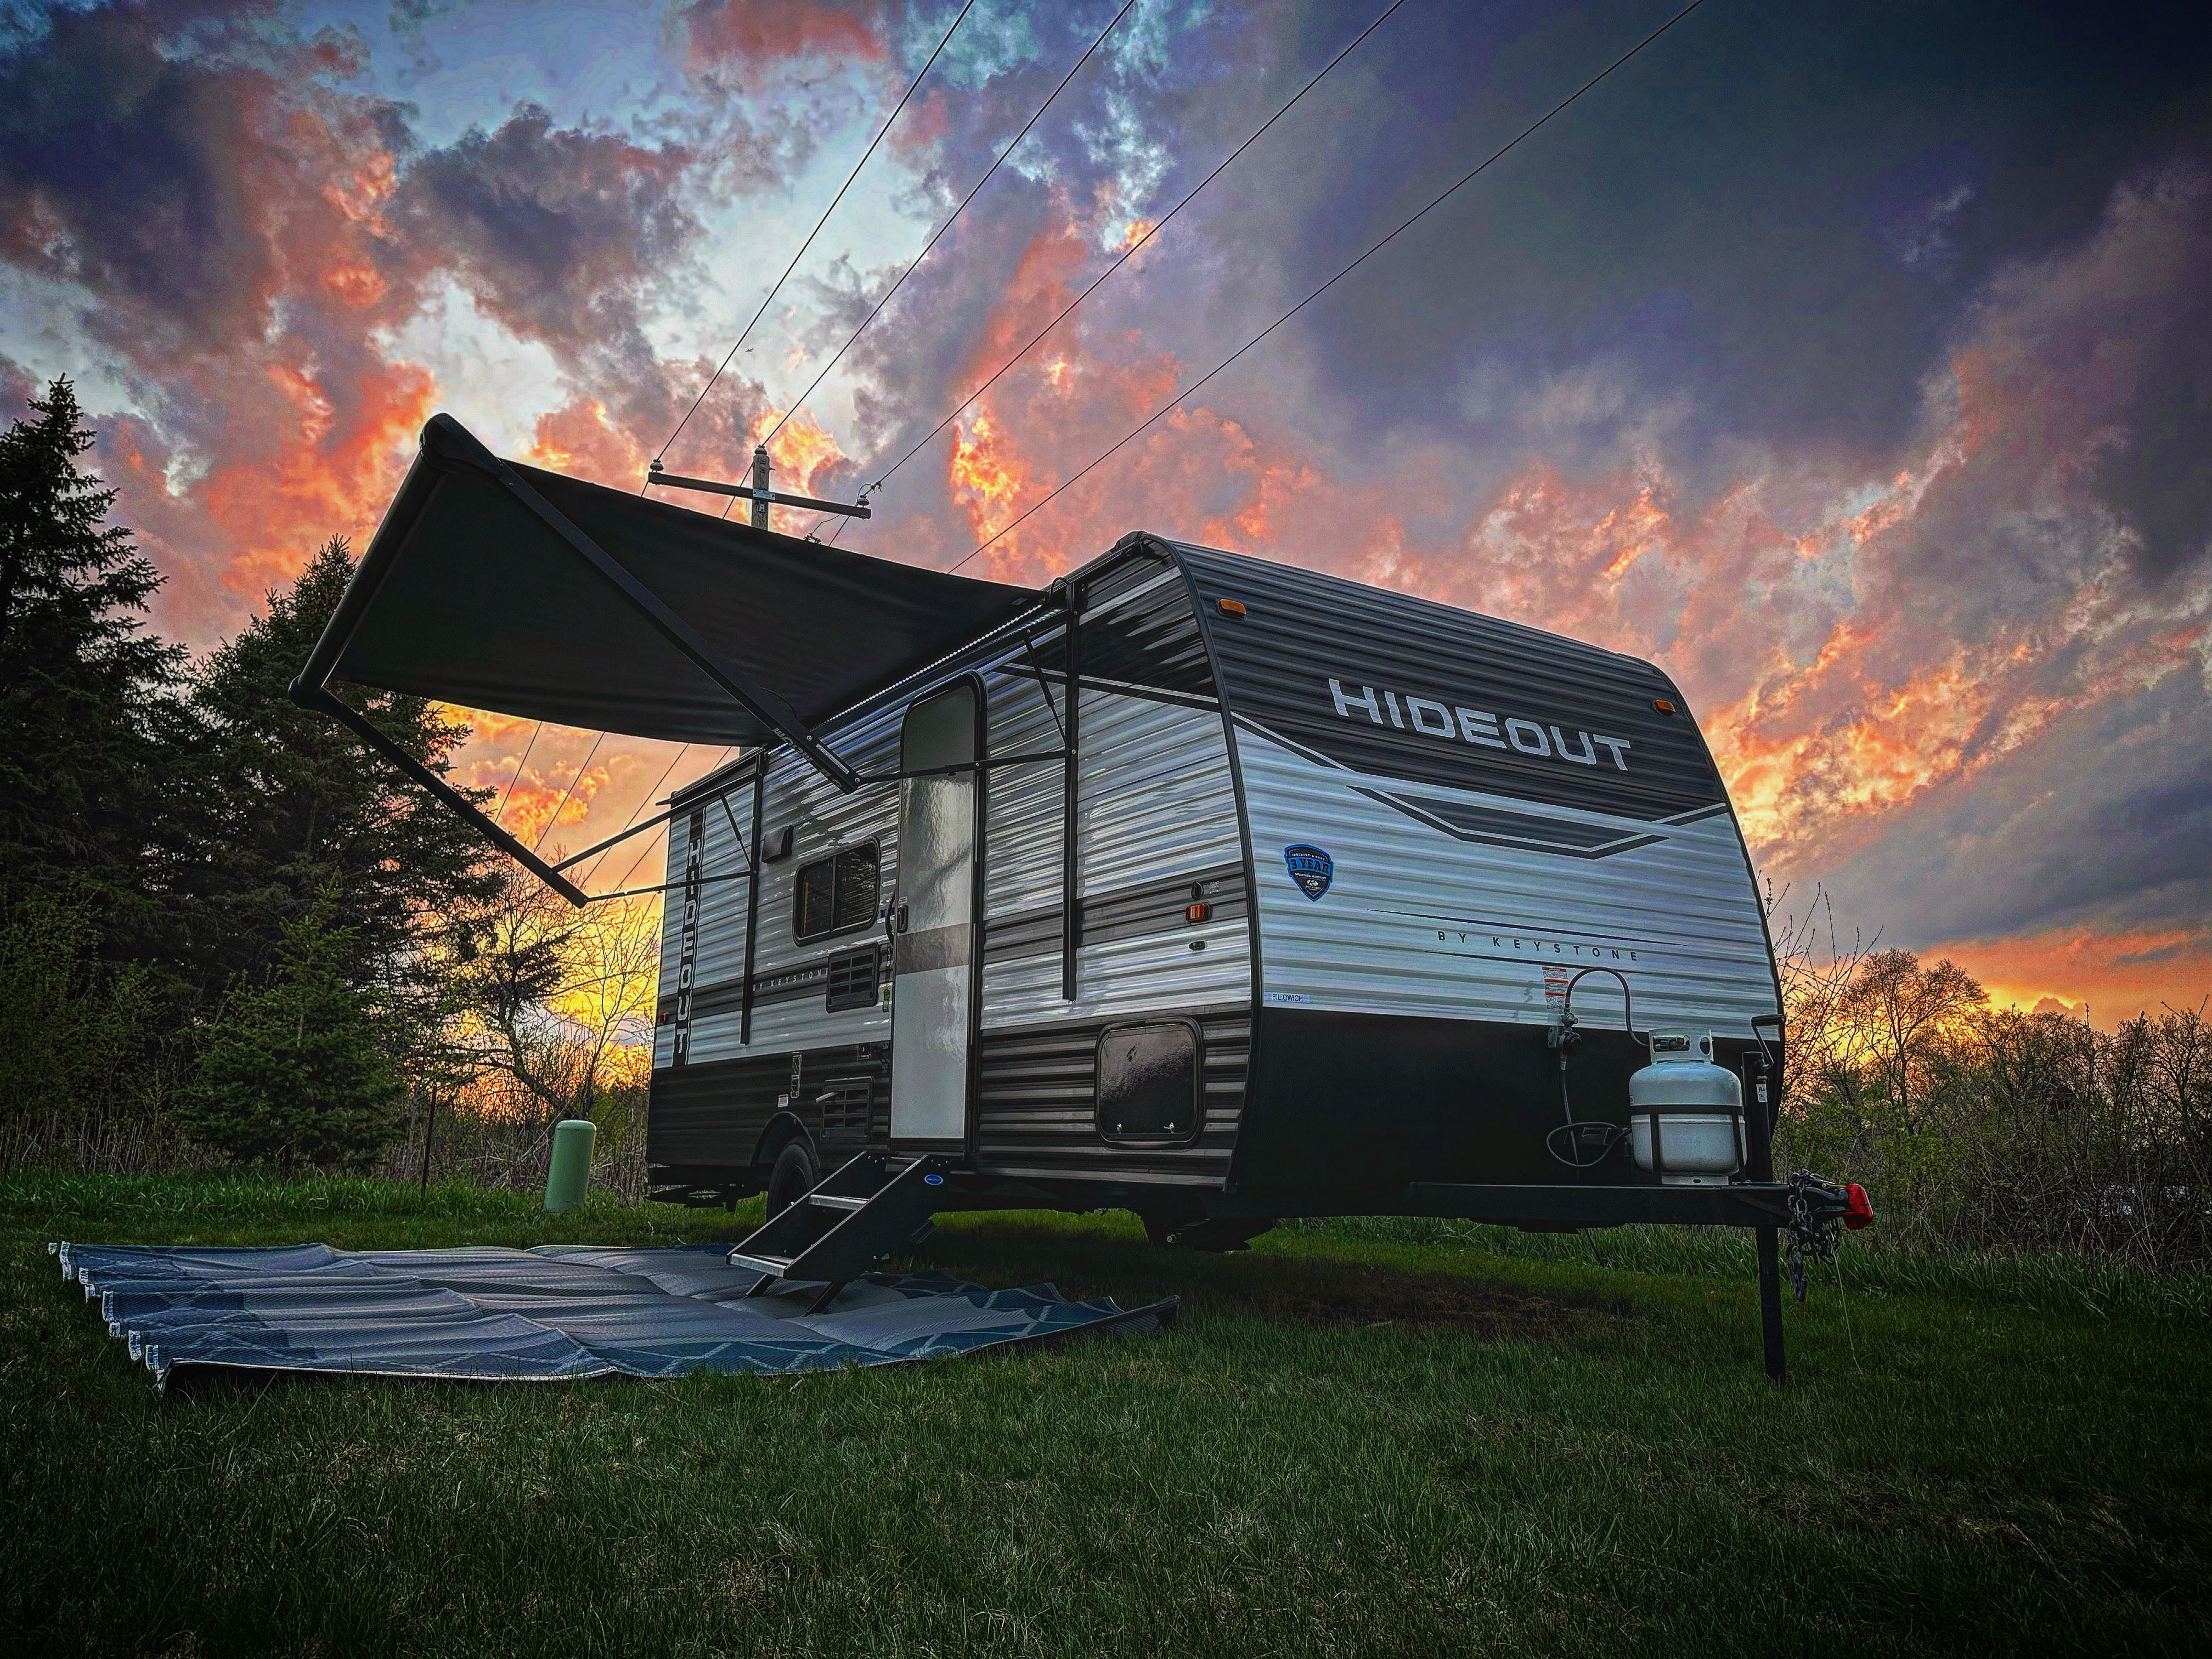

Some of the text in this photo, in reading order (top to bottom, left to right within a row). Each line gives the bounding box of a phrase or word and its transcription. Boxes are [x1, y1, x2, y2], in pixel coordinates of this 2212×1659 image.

[1328, 678, 1632, 771] HIDEOUT
[1290, 858, 1330, 874] 3 YEAR
[676, 839, 701, 1054] HIDEOUT
[1437, 931, 1637, 961] BY KEYSTONE
[752, 982, 763, 991] BY
